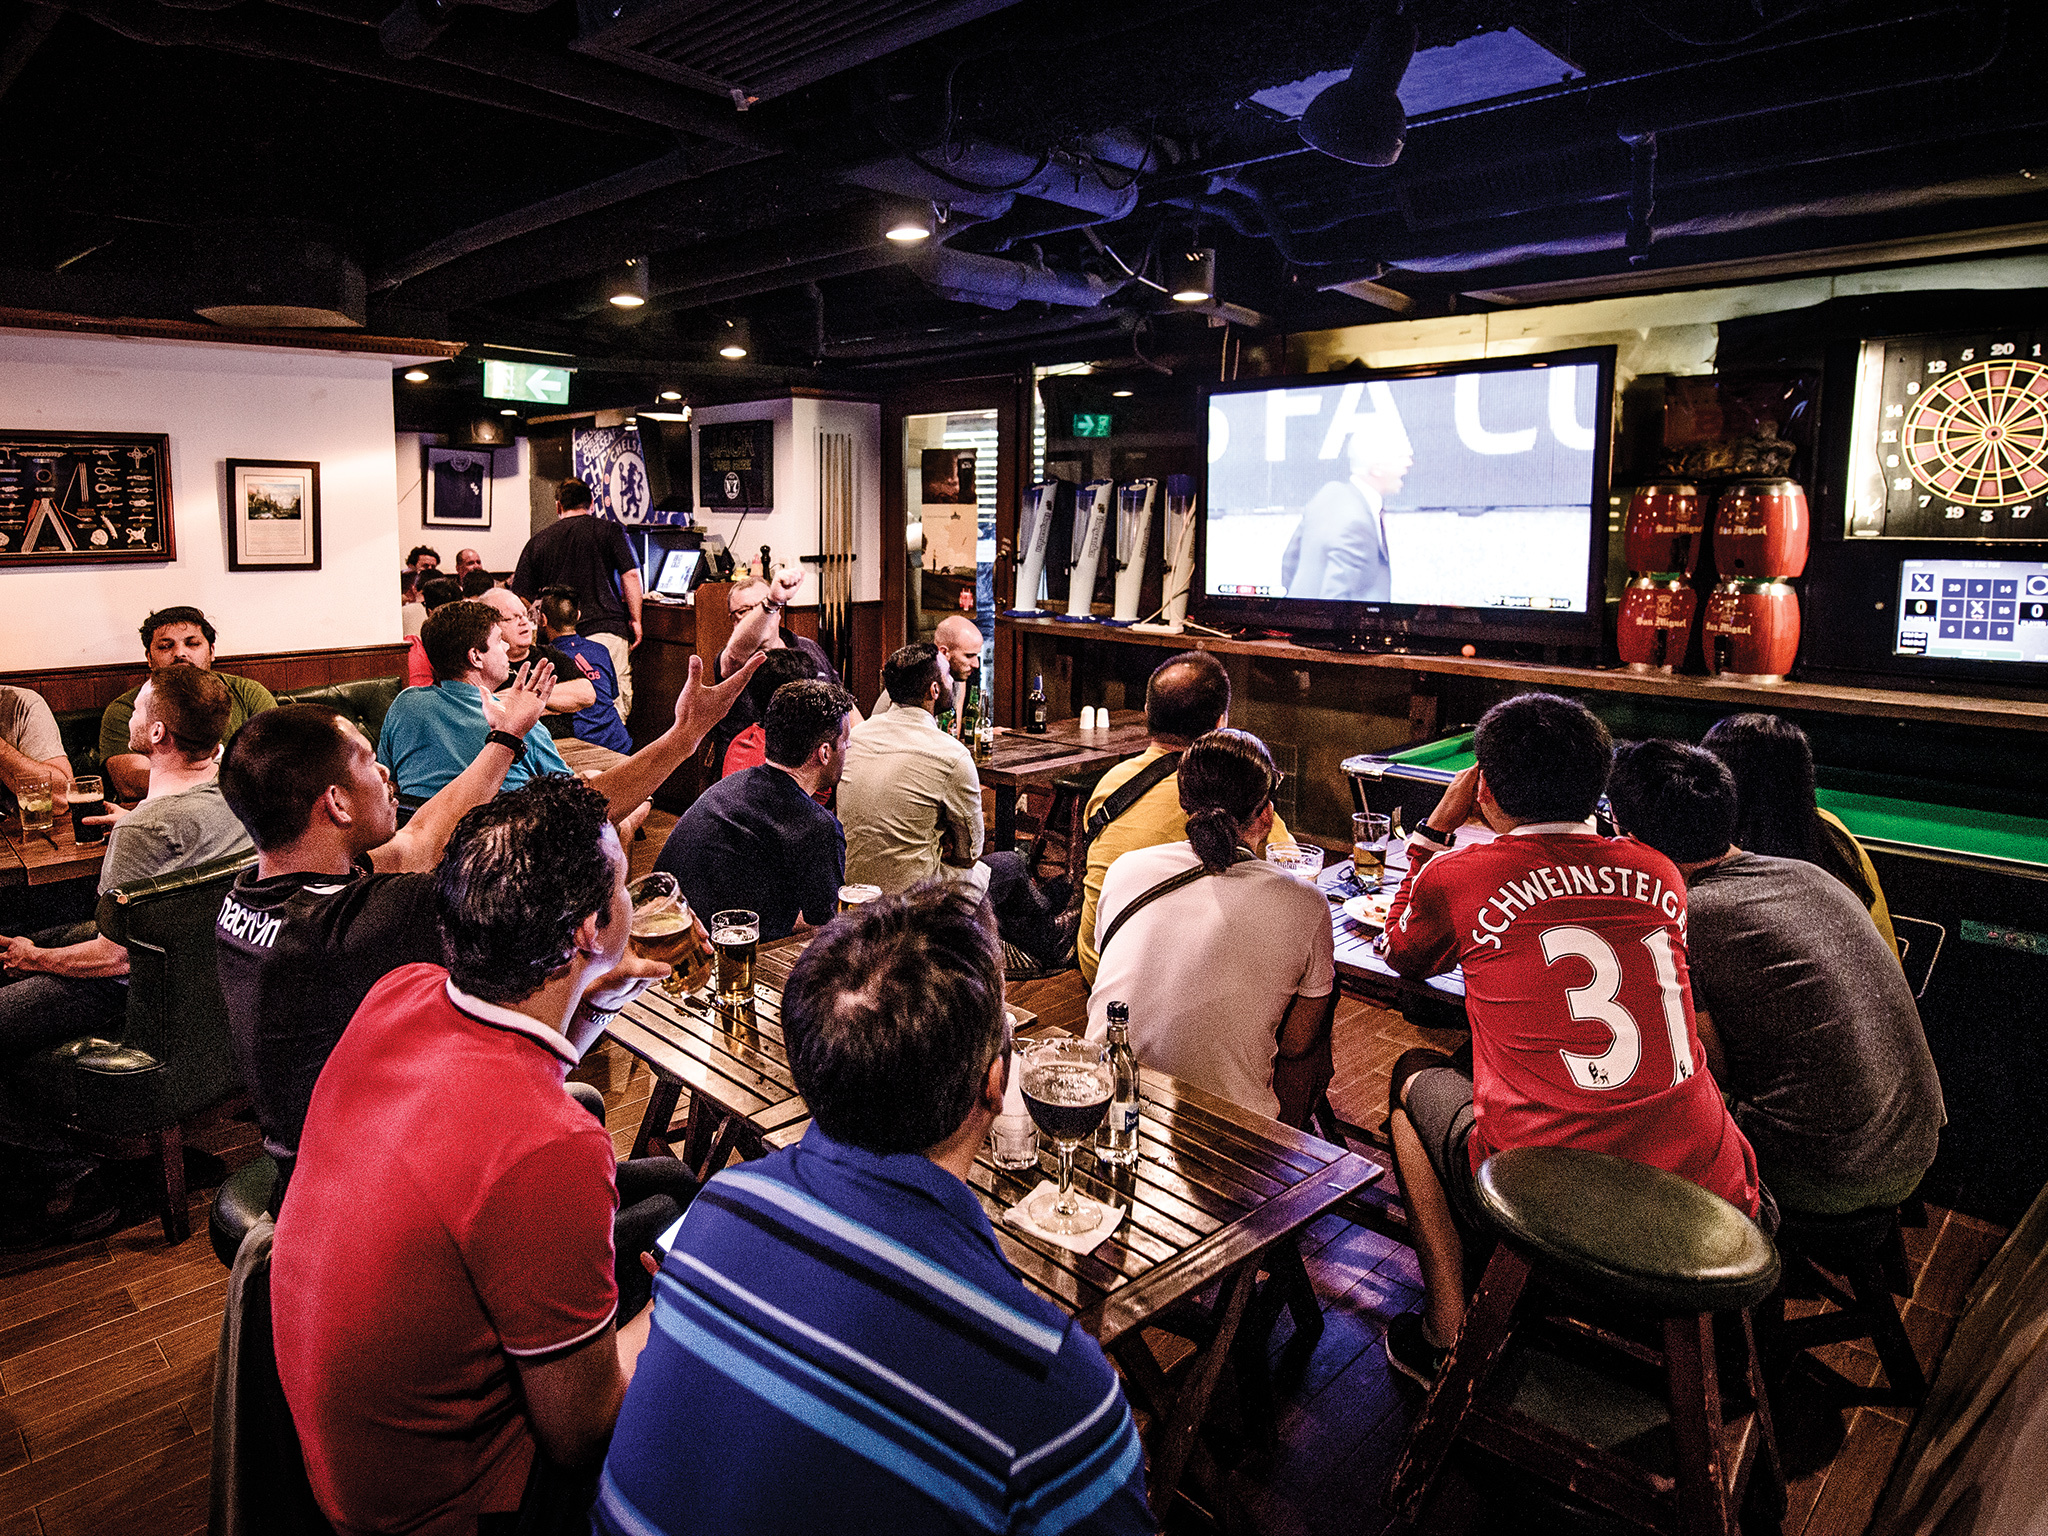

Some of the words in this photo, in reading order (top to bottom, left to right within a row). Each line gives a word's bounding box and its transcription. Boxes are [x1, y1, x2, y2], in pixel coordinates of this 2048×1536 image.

[1961, 348, 1974, 361] 5
[1990, 342, 2015, 356] 20
[2032, 343, 2041, 357] 1
[1928, 360, 1947, 373] 12
[1907, 382, 1920, 395] 9
[1885, 404, 1903, 417] 14
[1265, 380, 1414, 462] FA
[1882, 430, 1897, 443] 11
[1886, 455, 1899, 468] 8
[1918, 495, 1931, 508] 7
[1945, 506, 1965, 519] 19
[2011, 505, 2032, 518] 17
[1948, 583, 1961, 592] 20
[1655, 616, 1687, 628] Miguel
[1539, 925, 1694, 1090] 31
